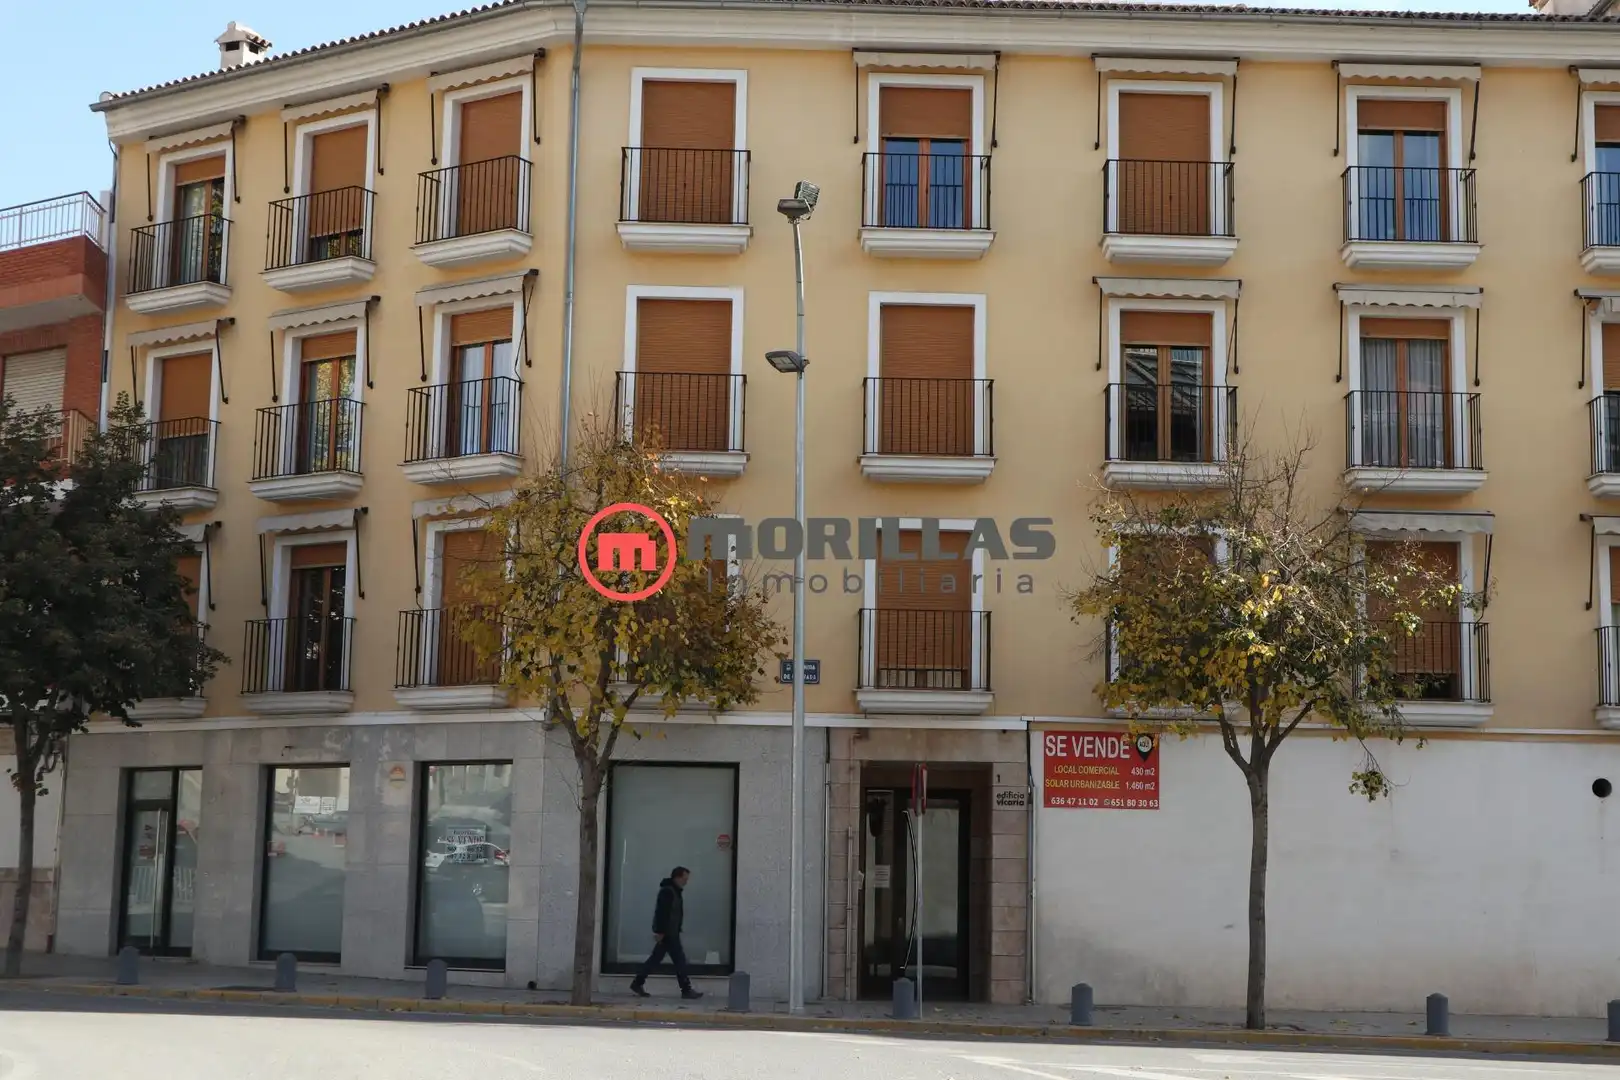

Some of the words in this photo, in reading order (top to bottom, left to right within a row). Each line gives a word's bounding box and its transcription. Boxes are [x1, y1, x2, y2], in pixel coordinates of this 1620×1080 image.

[1045, 735, 1067, 757] SE
[1072, 736, 1130, 759] VENDE
[1054, 765, 1078, 774] LOCAL
[1078, 766, 1120, 775] COMERCIAL
[1144, 768, 1155, 776] m2
[1045, 779, 1069, 788] SOLAR
[1070, 780, 1120, 789] URBANIZABLE
[1144, 782, 1155, 791] m2
[1051, 797, 1065, 805] 636
[1089, 798, 1098, 806] 02
[1111, 799, 1124, 807] 651
[1127, 799, 1136, 807] 80
[1138, 799, 1148, 807] 30
[1149, 799, 1158, 807] 63
